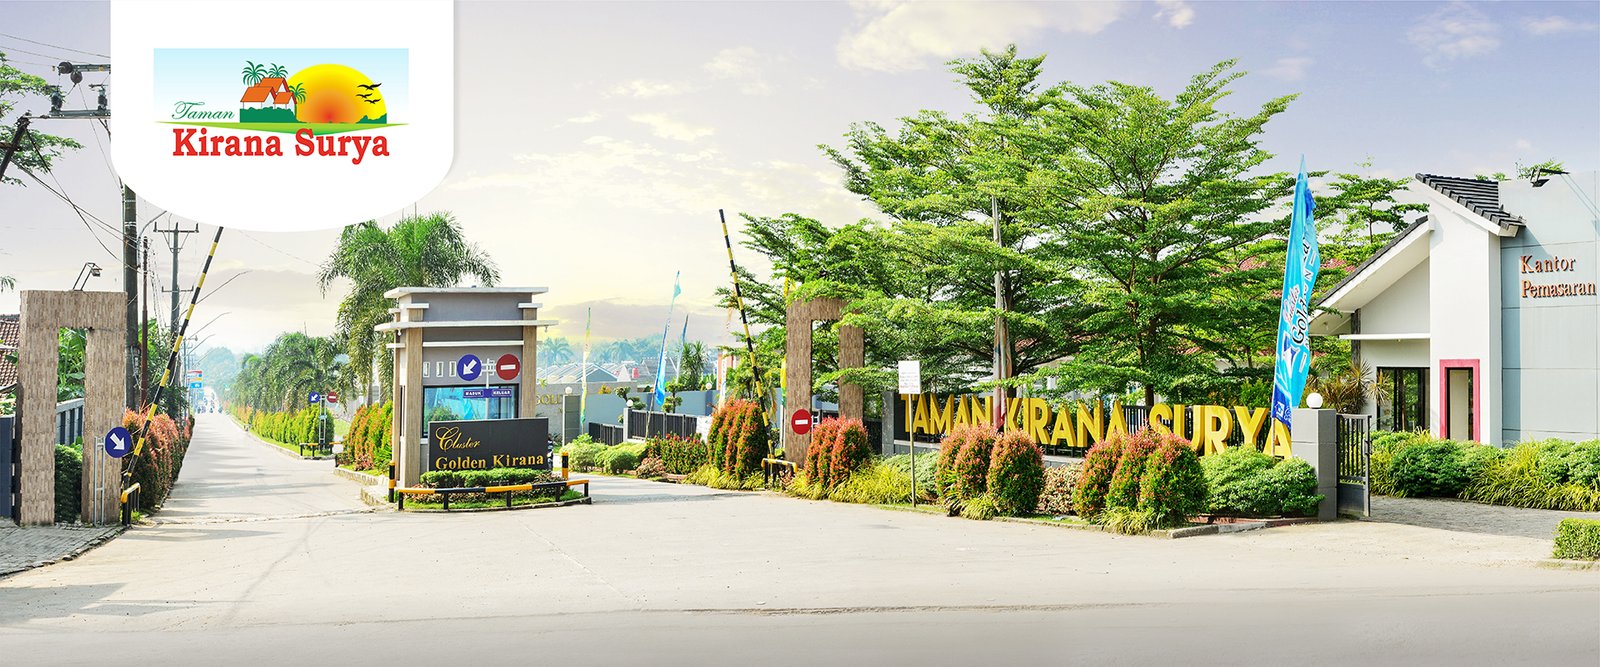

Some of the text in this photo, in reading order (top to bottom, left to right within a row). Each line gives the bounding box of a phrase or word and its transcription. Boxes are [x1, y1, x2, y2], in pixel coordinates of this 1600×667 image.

[1520, 255, 1576, 274] Kantor
[1521, 280, 1597, 298] Pemasaran
[900, 393, 1292, 460] TAMAN KIRANA SURYA
[435, 426, 481, 452] Cluster
[435, 454, 544, 470] Golden Kirana
